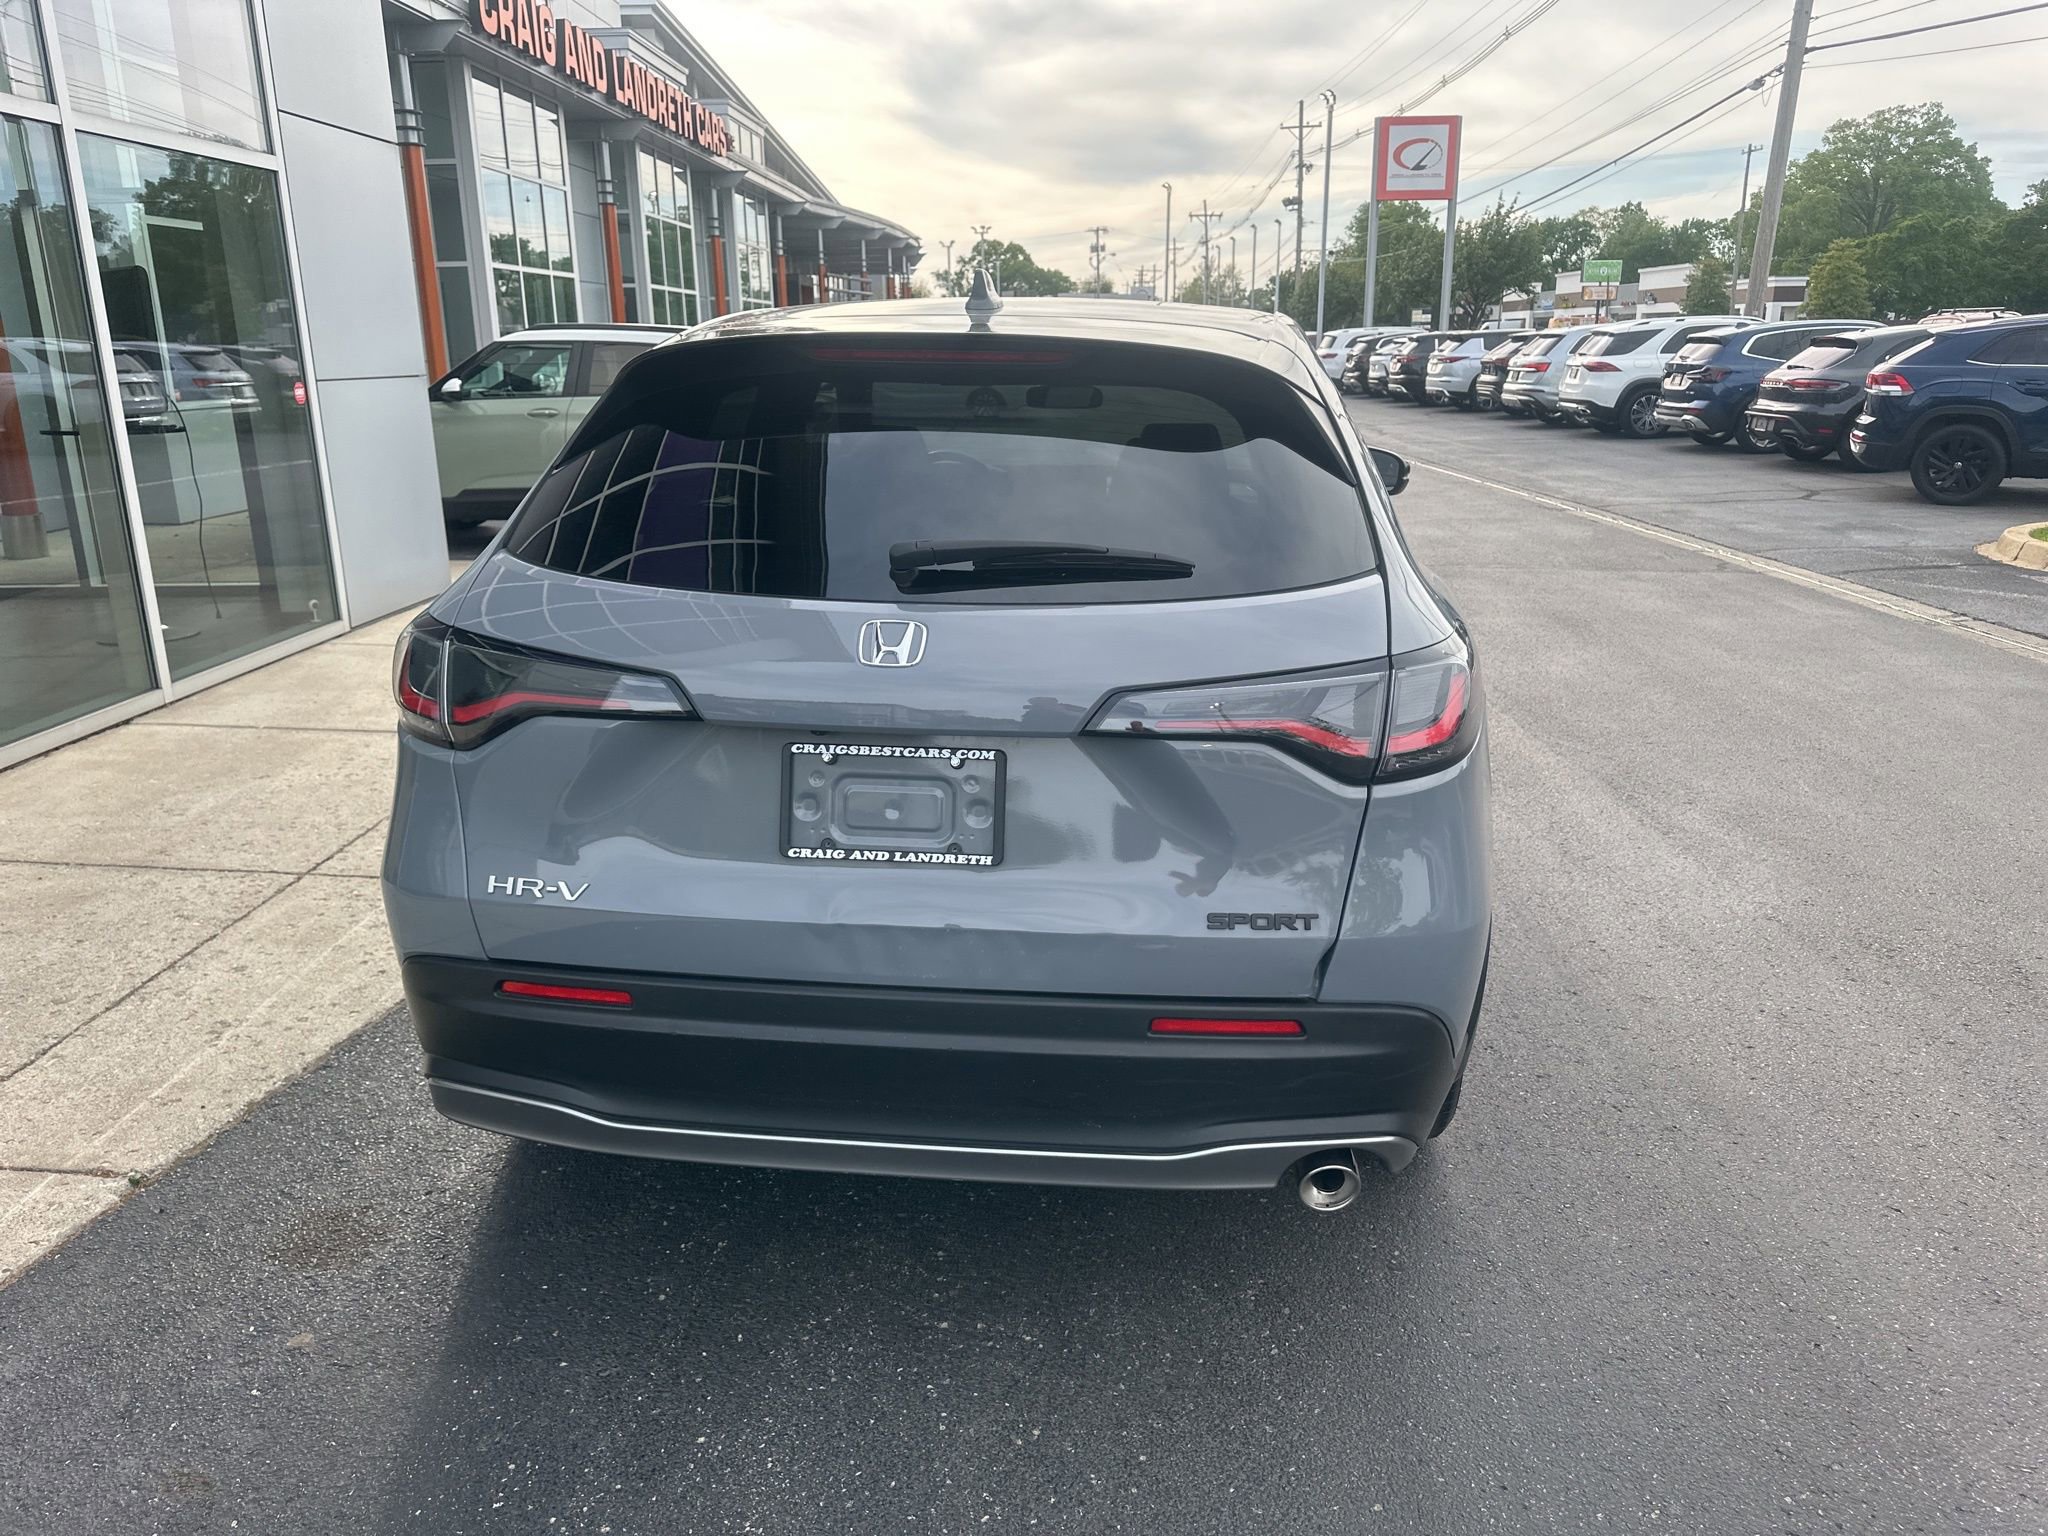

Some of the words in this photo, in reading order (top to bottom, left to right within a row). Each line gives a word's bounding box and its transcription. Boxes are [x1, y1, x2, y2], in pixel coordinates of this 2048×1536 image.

[562, 18, 608, 95] AND
[611, 49, 694, 141] LANDRETH
[694, 104, 728, 158] CARS
[790, 743, 996, 761] CRAIGSBESTCARS.COM
[787, 847, 846, 859] CRAIG
[848, 850, 890, 862] AND
[893, 852, 994, 866] LANDRETH
[487, 875, 590, 901] HR-V
[1206, 912, 1320, 931] SPORT
